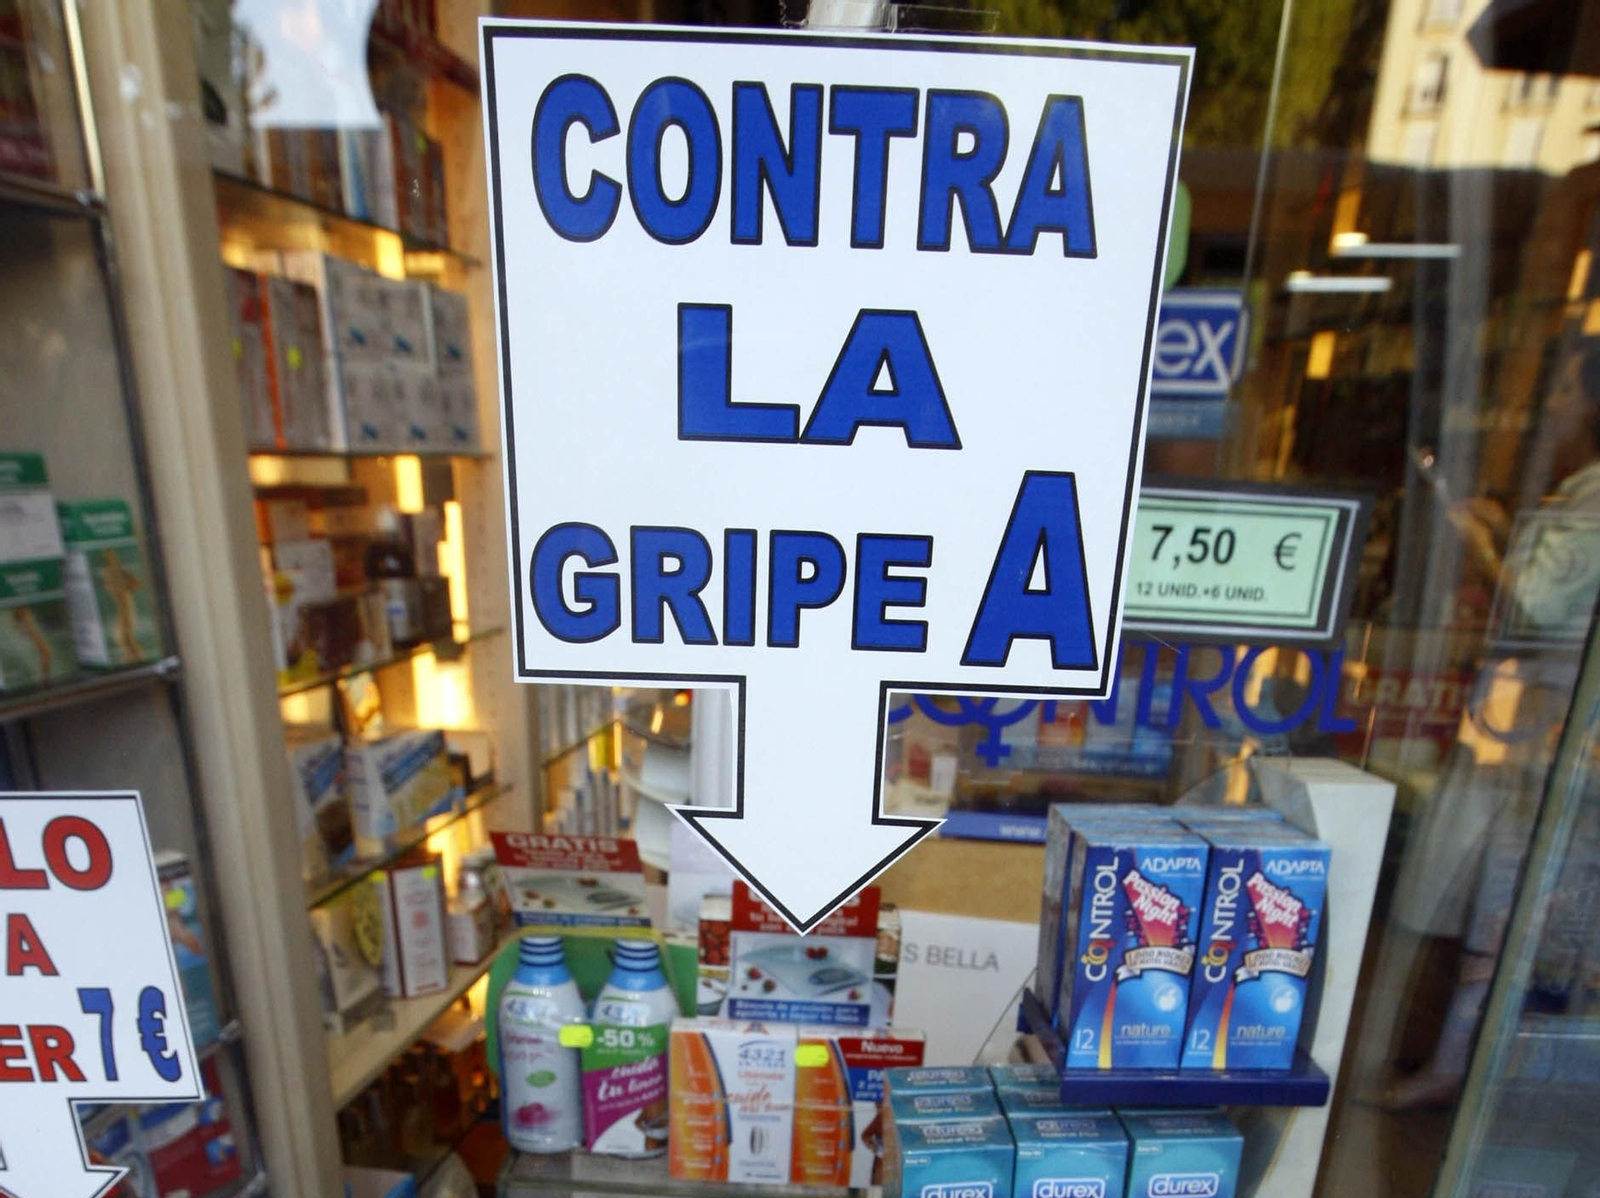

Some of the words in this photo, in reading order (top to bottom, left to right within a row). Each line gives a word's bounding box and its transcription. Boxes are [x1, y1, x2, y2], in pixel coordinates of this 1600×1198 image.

[531, 73, 1098, 259] CONTRA
[677, 302, 963, 450] LA
[1150, 525, 1237, 570] 7,50
[1273, 531, 1302, 571] €
[530, 521, 934, 652] GRIPE
[960, 470, 1098, 670] A
[1136, 581, 1153, 597] 12
[505, 833, 619, 853] GRATIS
[1140, 857, 1201, 872] ADAPTA
[1266, 859, 1325, 874] ADAPTA
[1122, 870, 1181, 911] Passion
[1246, 872, 1303, 912] Passion
[1082, 856, 1118, 982] CONTROL
[1133, 895, 1178, 925] Night
[1202, 858, 1244, 982] CONTROL
[1255, 897, 1300, 927] Night
[7, 913, 60, 976] A
[926, 944, 1000, 973] BELLA
[1074, 1028, 1094, 1050] 12
[1121, 1023, 1171, 1037] nature
[1191, 1029, 1210, 1050] 12
[1236, 1024, 1286, 1037] nature
[861, 1040, 904, 1054] Nuevo
[1151, 1174, 1216, 1198] durex
